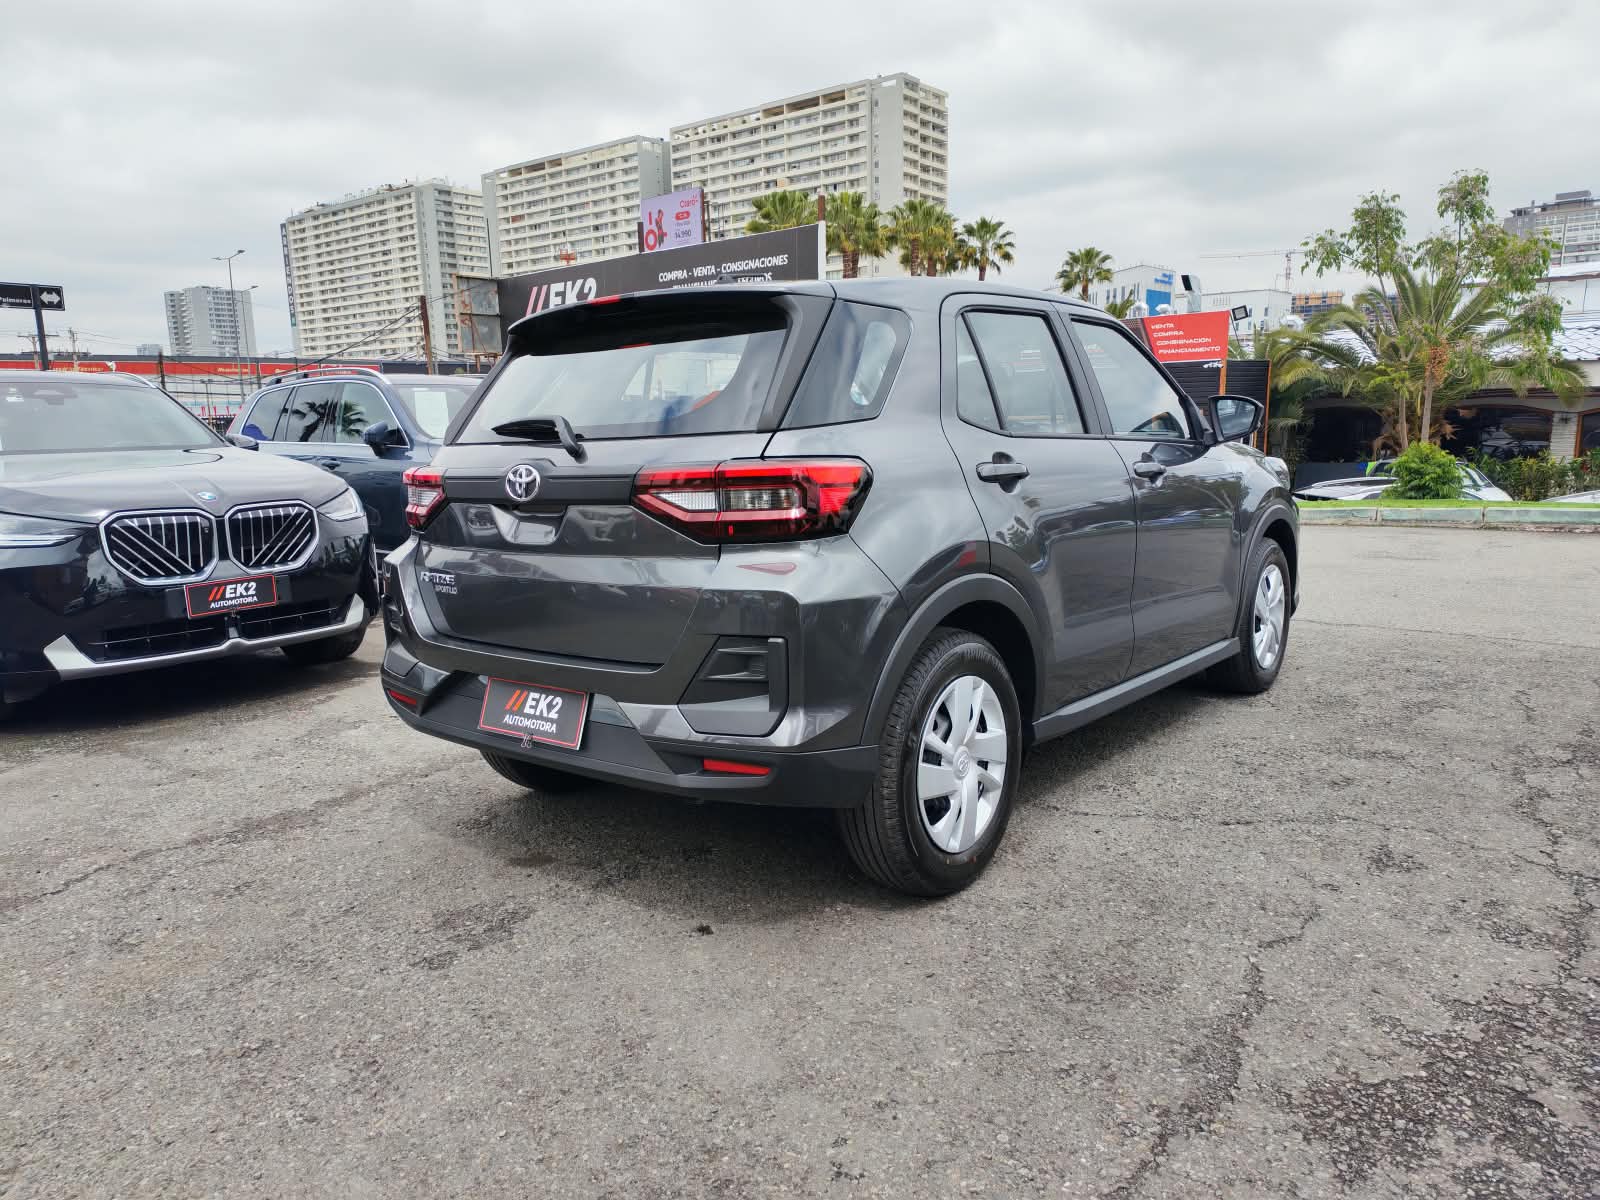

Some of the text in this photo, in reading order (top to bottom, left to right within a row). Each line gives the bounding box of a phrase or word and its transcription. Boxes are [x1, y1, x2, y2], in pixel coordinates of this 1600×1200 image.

[658, 269, 687, 282] COMPRA
[693, 265, 716, 277] VENTA
[721, 254, 789, 273] CONSIGNACIONES
[1153, 330, 1184, 338] COMPRA
[210, 595, 258, 609] AUTOMOTORA
[503, 714, 557, 733] AUTOMOTORA
